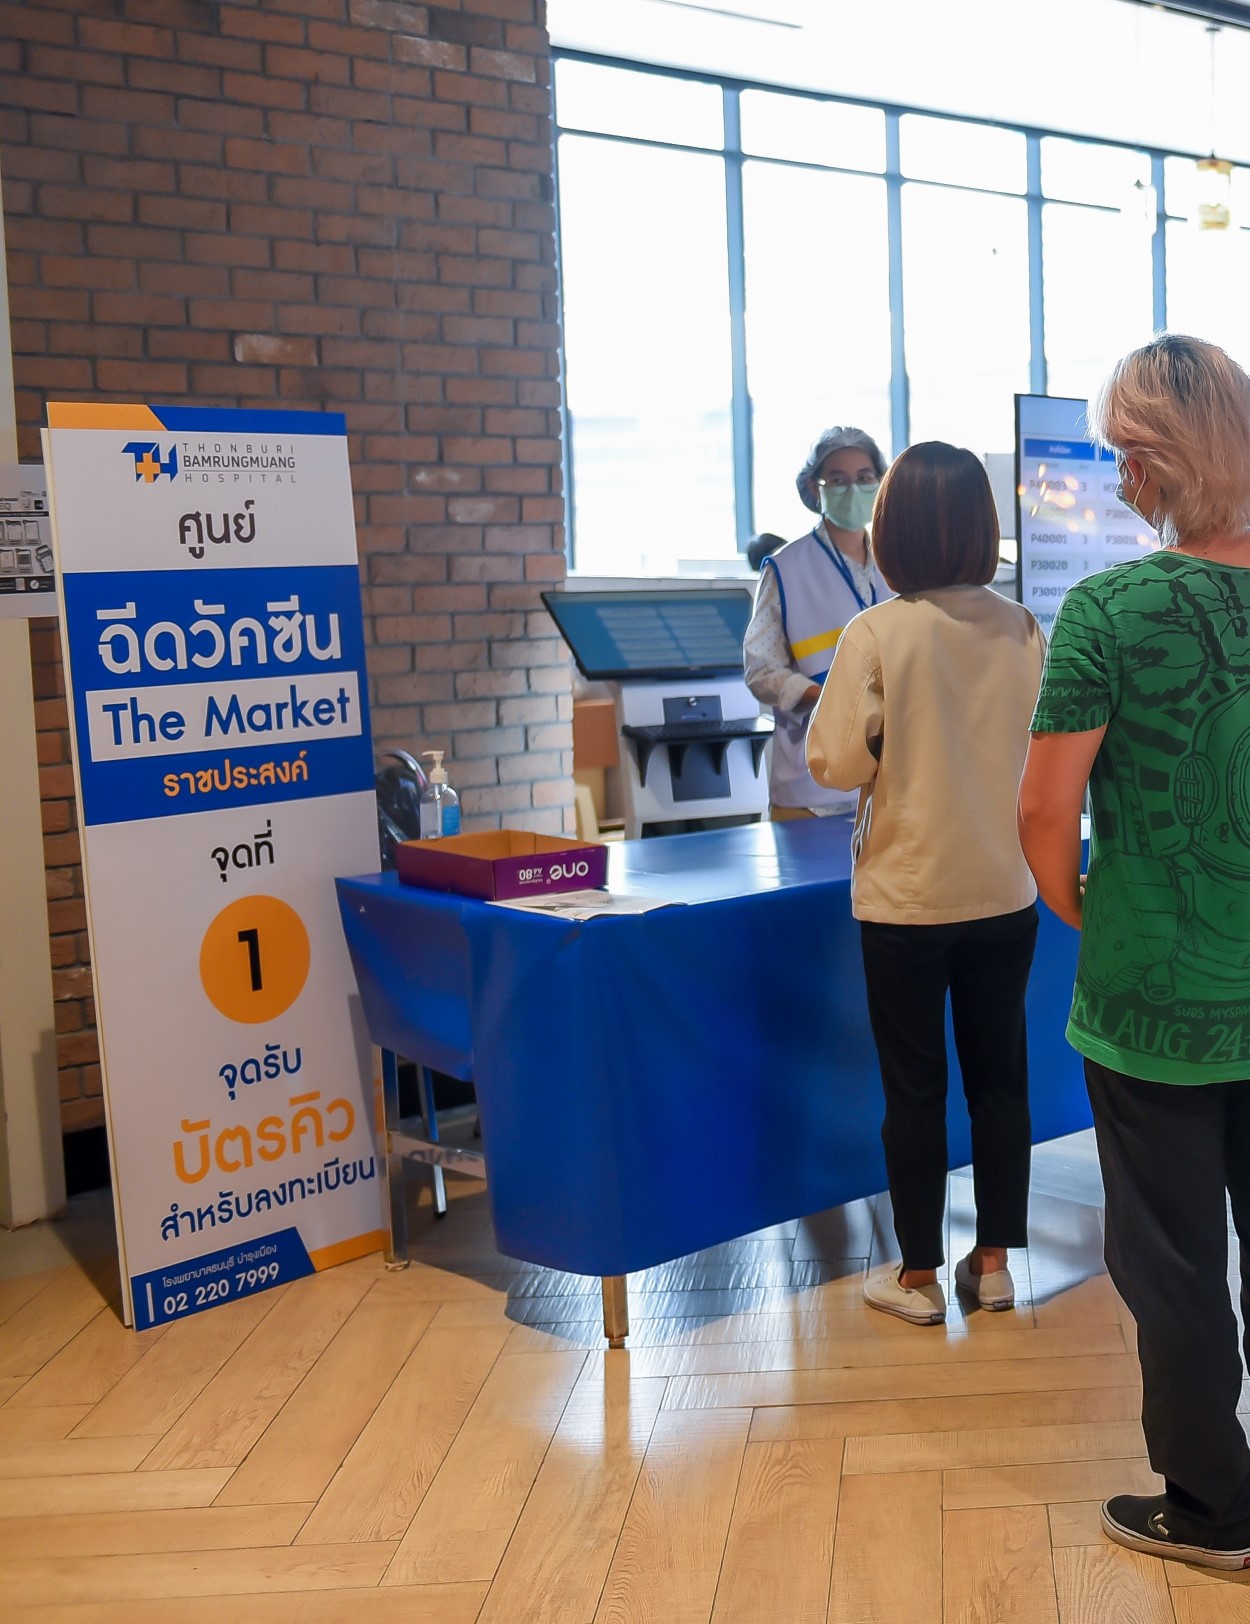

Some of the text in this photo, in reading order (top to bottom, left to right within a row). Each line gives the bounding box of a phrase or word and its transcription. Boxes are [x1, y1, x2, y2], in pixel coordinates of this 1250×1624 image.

[182, 443, 294, 454] THONBURI
[183, 455, 296, 469] BAMRUNGMUANG
[185, 473, 296, 484] HOSPITAL
[177, 499, 257, 559] ศูนย์
[1030, 533, 1068, 545] P40001
[1030, 560, 1069, 571] P30020
[96, 594, 342, 674] ฉีดวัคซีน
[102, 684, 351, 746] The Market
[162, 751, 308, 798] ราชประสงค์
[210, 820, 276, 882] จุดที่
[519, 868, 533, 881] 80
[549, 861, 589, 880] one
[237, 928, 263, 992] 1
[1111, 1009, 1193, 1060] AUG
[218, 1043, 302, 1101] จุดรับ
[173, 1091, 356, 1185] บัตรคิว
[160, 1156, 376, 1242] สำหรับลงทะเบียน
[163, 1262, 280, 1315] 02 220 7999
